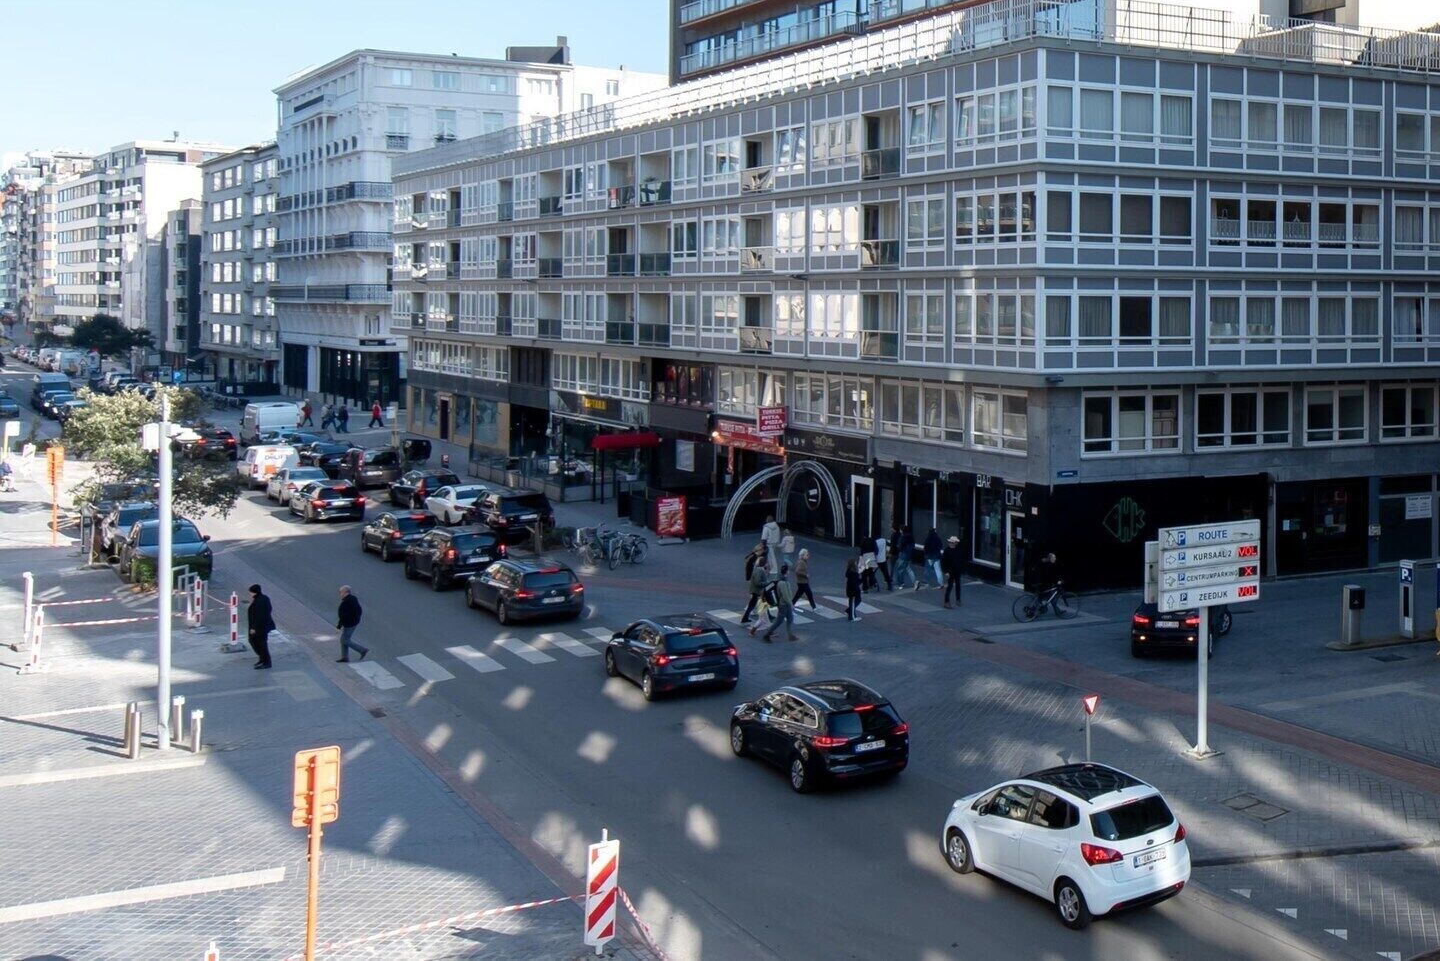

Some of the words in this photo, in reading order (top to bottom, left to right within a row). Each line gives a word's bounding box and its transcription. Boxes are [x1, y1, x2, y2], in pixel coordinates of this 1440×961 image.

[1198, 530, 1228, 541] ROUTE
[1193, 551, 1226, 561] KURSAAL
[1238, 546, 1257, 557] VOL
[1186, 570, 1239, 582] CENTRUMPARKING
[1199, 591, 1228, 601] ZEEDIJK
[1238, 585, 1257, 597] VOL
